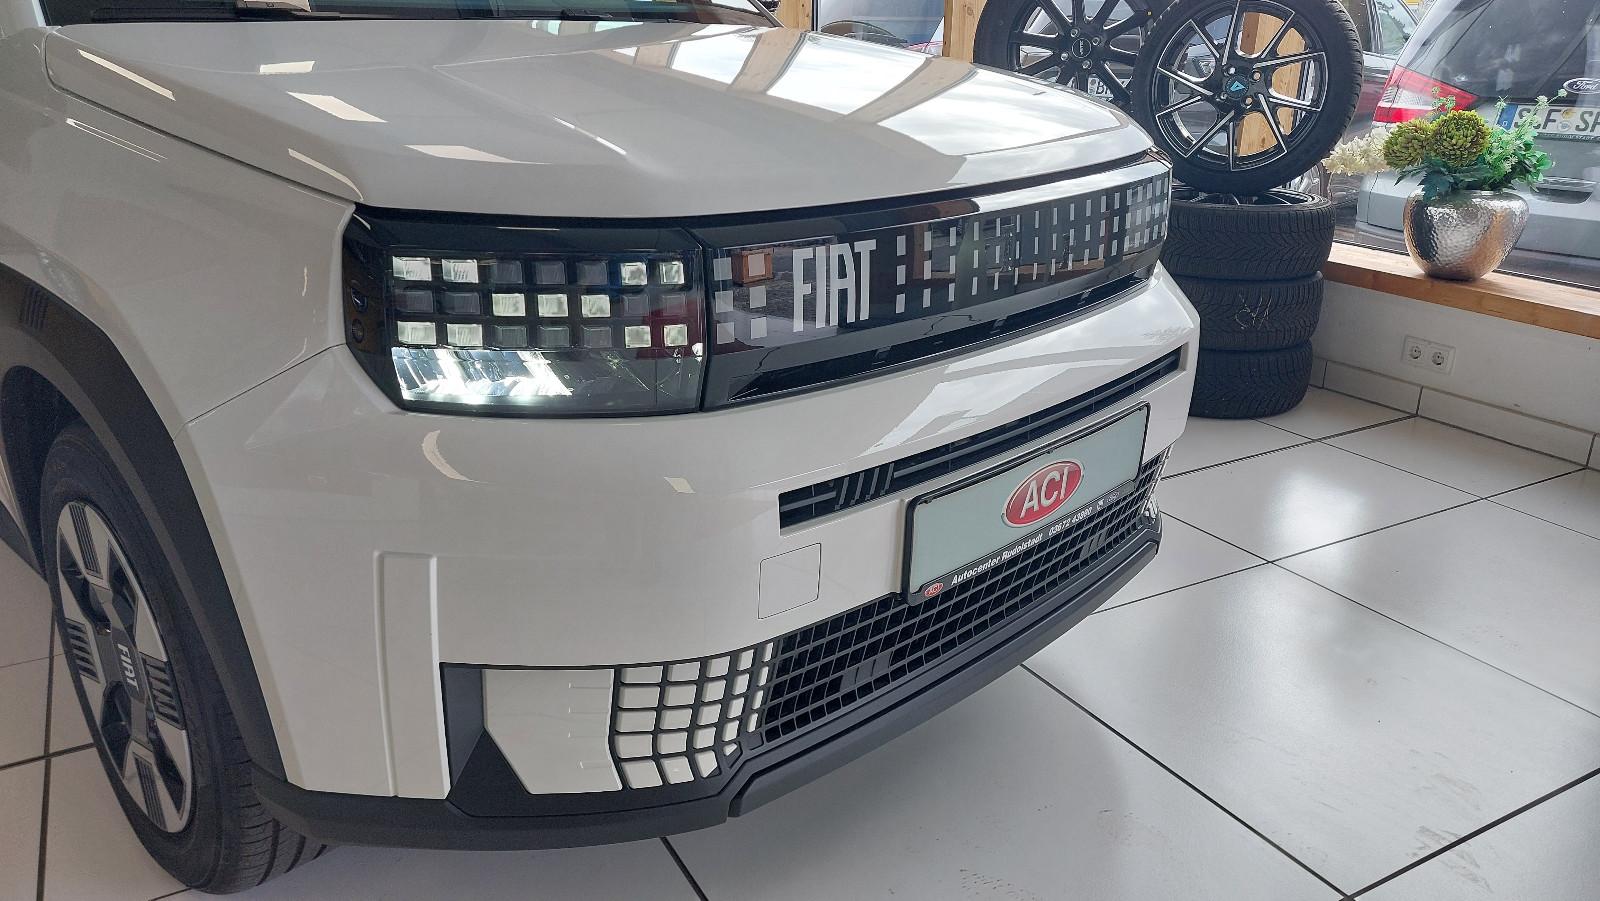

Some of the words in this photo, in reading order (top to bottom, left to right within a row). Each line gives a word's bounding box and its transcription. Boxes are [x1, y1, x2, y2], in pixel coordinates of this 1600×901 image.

[1573, 80, 1599, 90] Ford
[792, 239, 877, 333] FIAT
[1020, 468, 1069, 519] ACI
[951, 555, 1001, 586] Autocenter
[1002, 533, 1043, 561] Rudolstadt
[117, 643, 139, 694] FIAT
